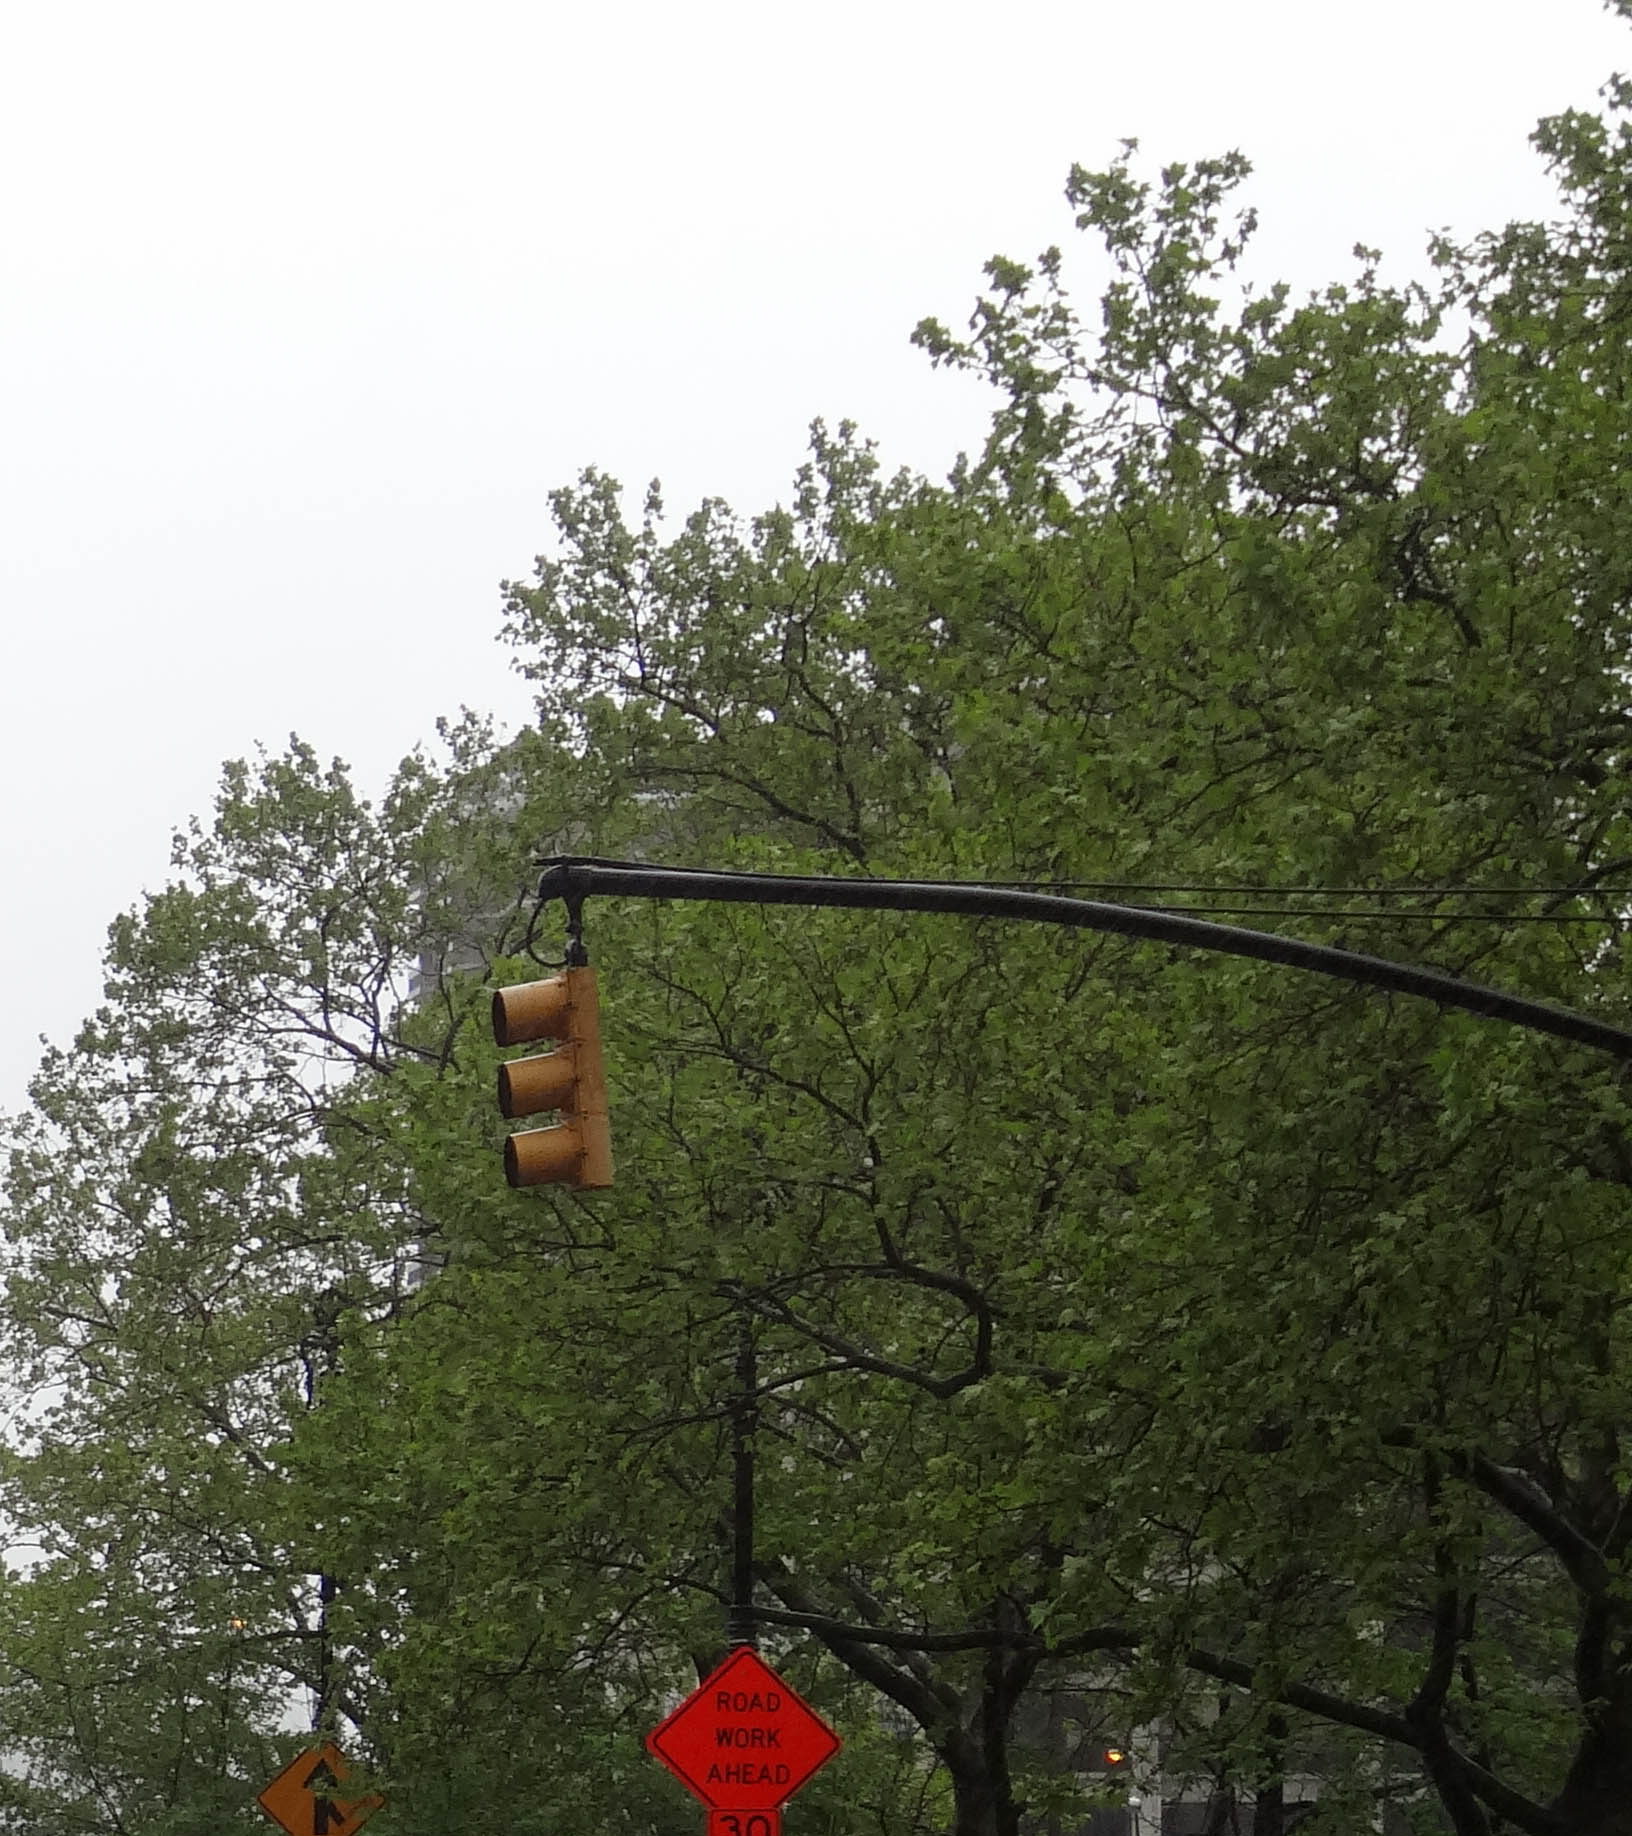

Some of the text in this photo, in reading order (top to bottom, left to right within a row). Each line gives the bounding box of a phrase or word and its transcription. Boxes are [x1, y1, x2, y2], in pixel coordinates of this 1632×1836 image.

[716, 1692, 781, 1713] ROAD
[715, 1728, 782, 1749] WORK
[706, 1764, 791, 1784] AHEAD
